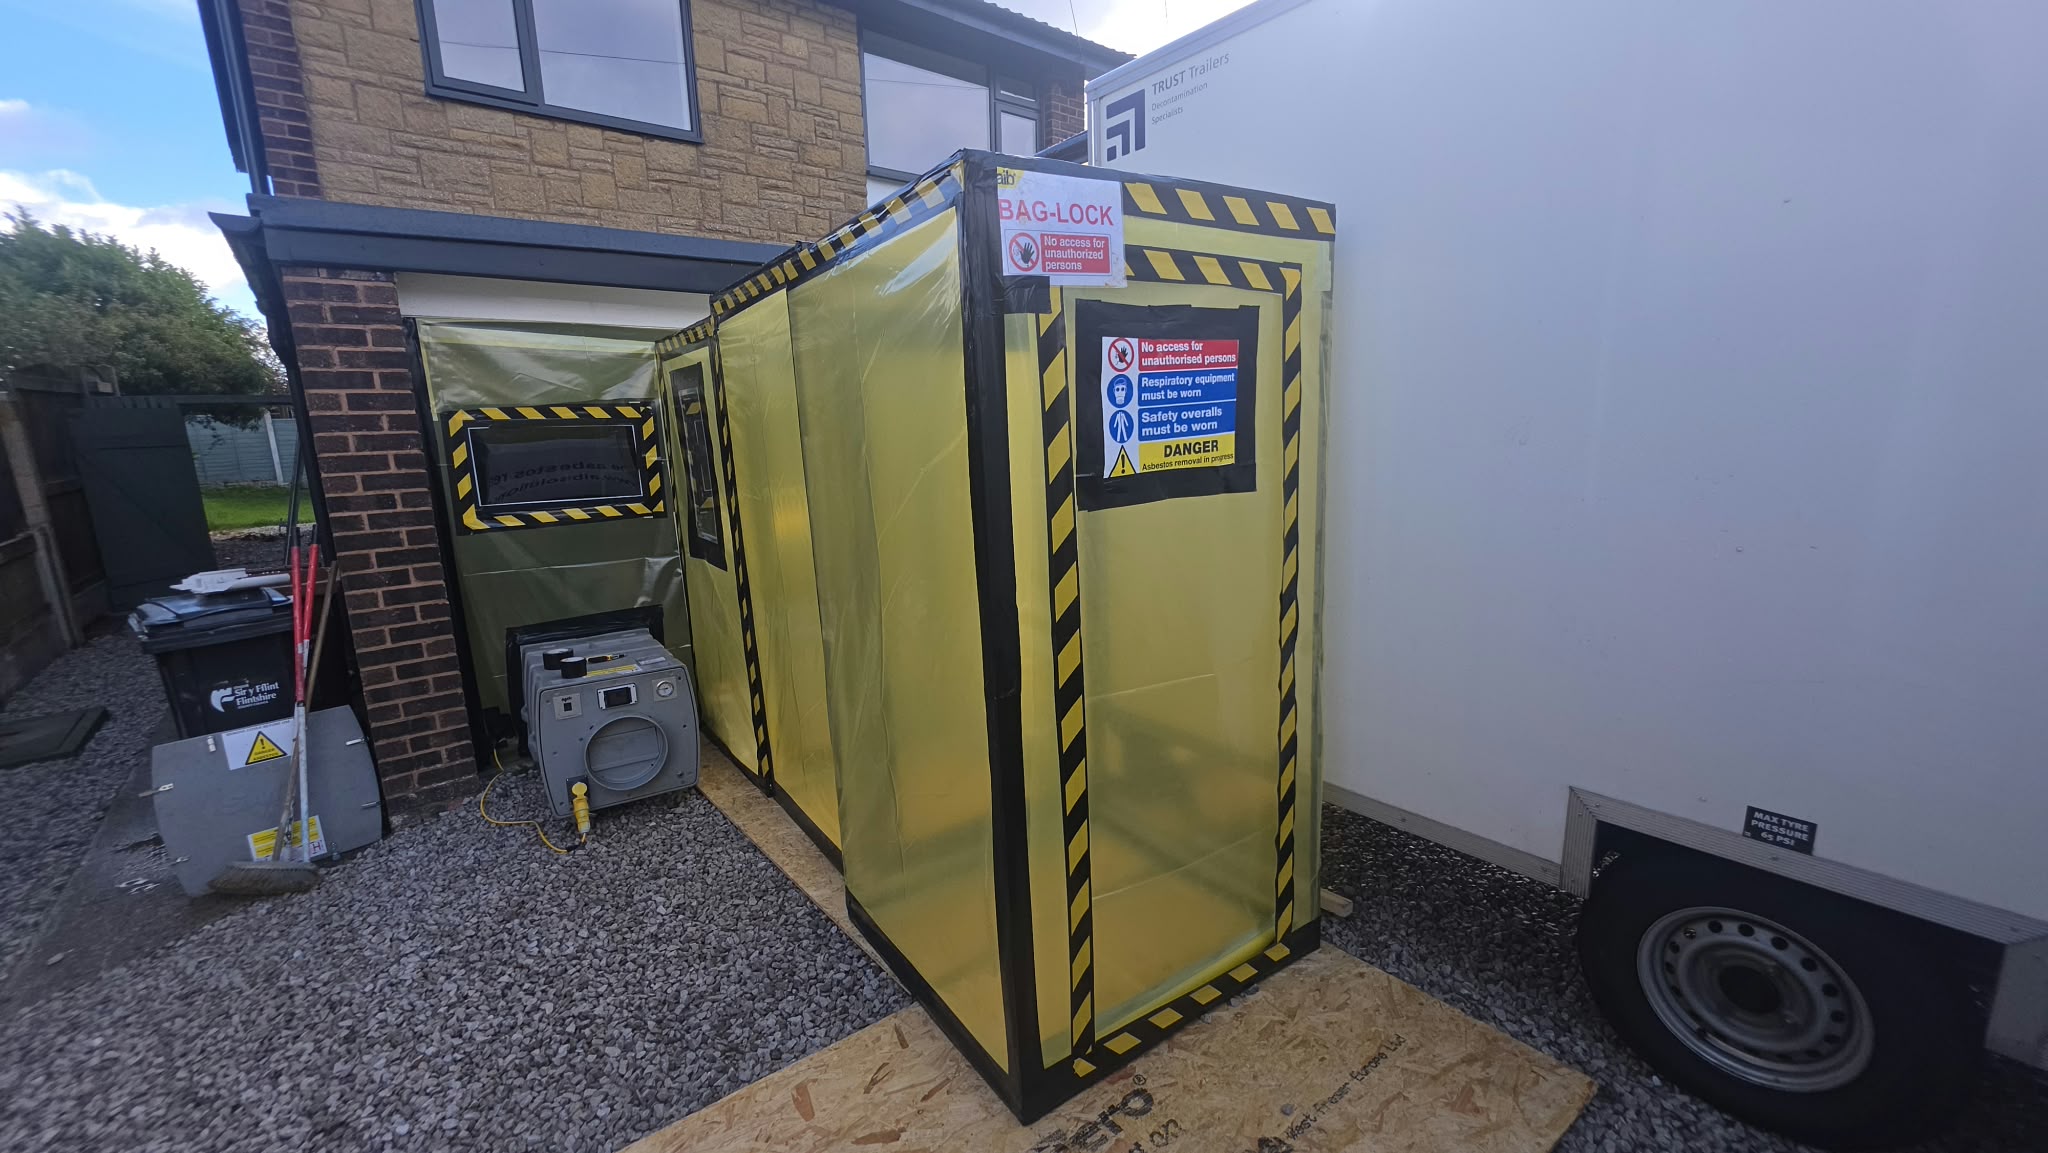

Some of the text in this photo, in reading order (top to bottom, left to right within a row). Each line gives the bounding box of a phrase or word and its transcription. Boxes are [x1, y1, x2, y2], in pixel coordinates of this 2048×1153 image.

[1151, 53, 1230, 95] TRUST Trailers
[1151, 82, 1208, 111] Decontamination
[1151, 107, 1184, 125] Specialists
[998, 199, 1114, 226] BAG-LOCK
[1044, 235, 1105, 248] No access for
[1044, 249, 1104, 260] unauthorized
[1045, 260, 1082, 272] persons
[1141, 340, 1204, 353] No access for
[1141, 354, 1237, 366] unauthorised persons
[1141, 373, 1235, 388] Respiratory equipment
[1141, 389, 1202, 401] must be worn
[1141, 406, 1223, 423] Safety overalls
[1141, 421, 1218, 437] must be worn
[1164, 440, 1219, 458] DANGER
[1142, 461, 1173, 471] Asbestos
[1174, 456, 1203, 467] removal
[1211, 453, 1234, 464] progress
[235, 692, 277, 706] Flintshire
[248, 688, 254, 697] y
[1753, 811, 1809, 832] MAX TYRE
[1751, 819, 1809, 842] PRESSURE
[1760, 831, 1795, 846] 65 PSI
[1349, 1052, 1388, 1081] Europe
